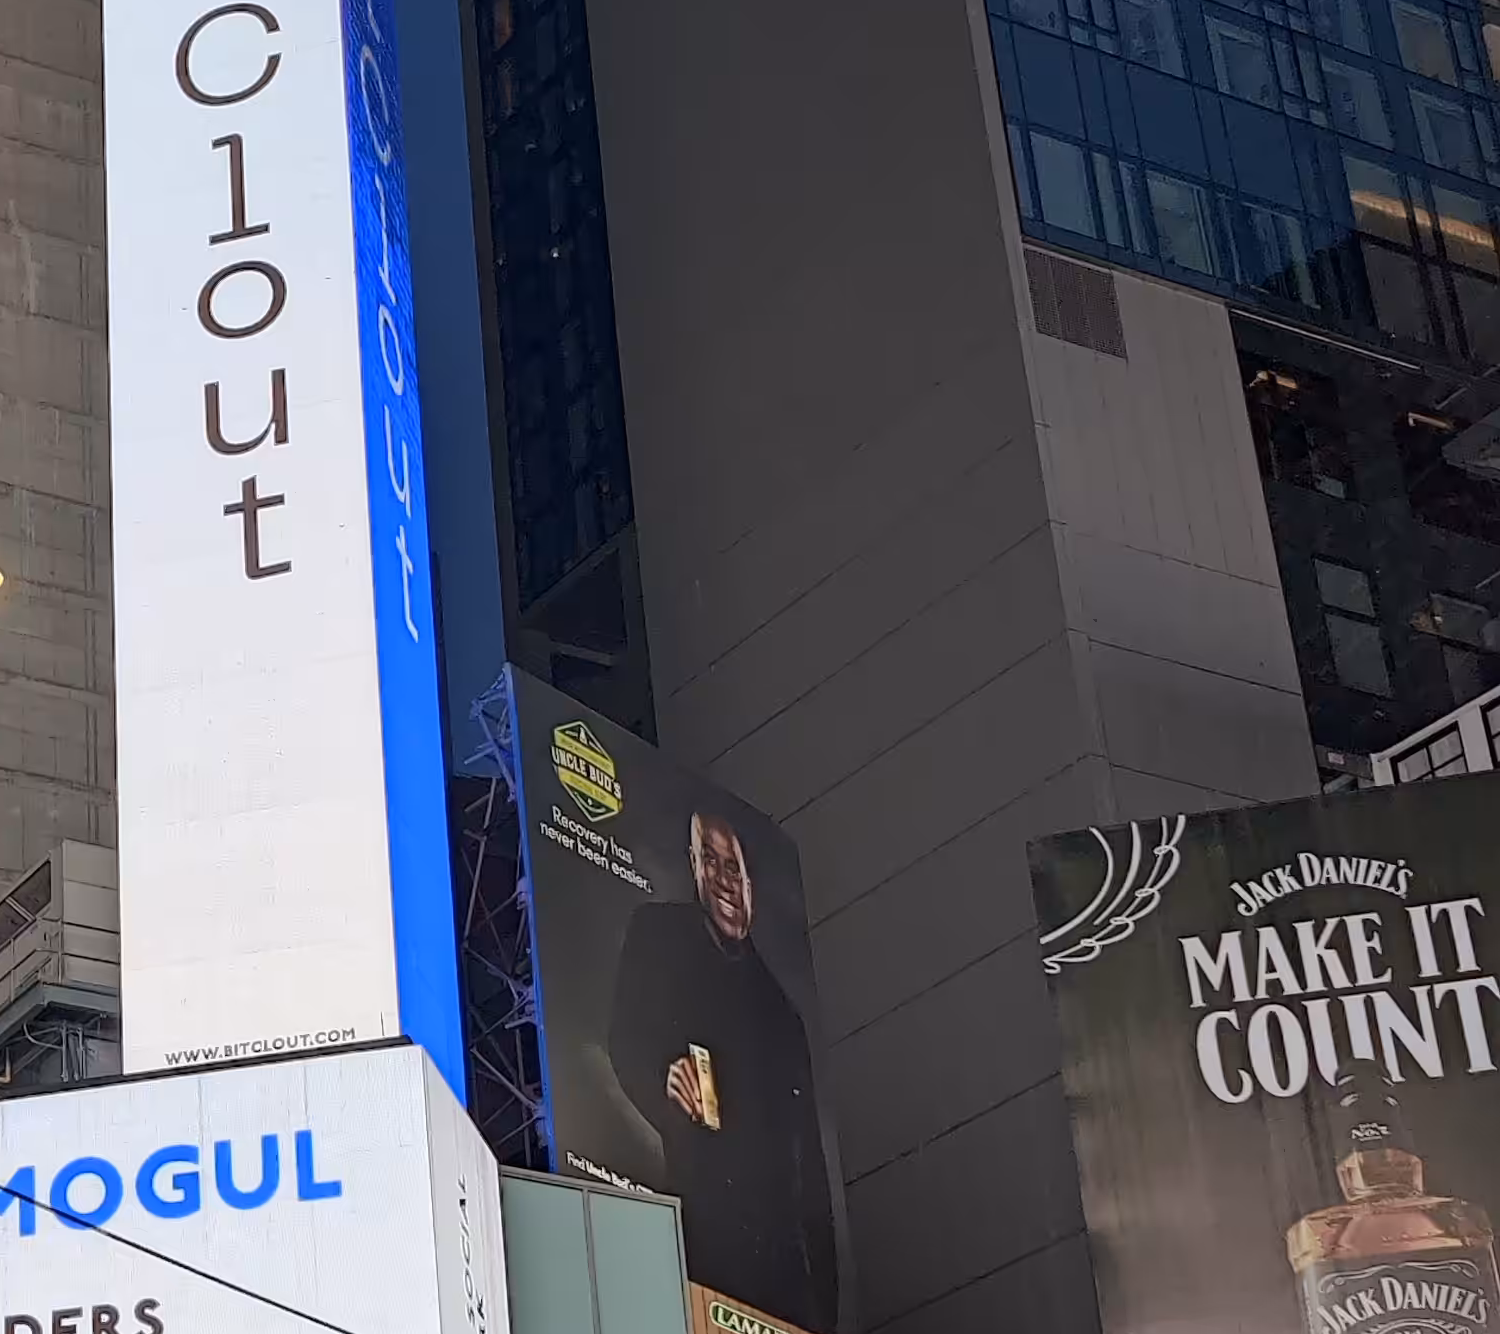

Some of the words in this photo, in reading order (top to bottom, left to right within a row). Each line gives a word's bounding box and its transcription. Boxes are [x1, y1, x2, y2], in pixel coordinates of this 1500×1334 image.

[551, 745, 587, 776] UNCLE
[588, 763, 622, 800] BUD'S
[539, 821, 576, 851] never
[577, 836, 610, 871] been
[611, 860, 654, 894] easier.
[551, 805, 609, 854] Recovery
[610, 836, 633, 865] has
[1228, 863, 1300, 918] JACK
[1298, 851, 1415, 900] DANIEL'S
[1178, 910, 1392, 1009] MAKE
[1404, 896, 1486, 980] IT
[164, 1027, 357, 1066] WWW.BITCLOUT.COM
[1195, 975, 1500, 1105] COUNT
[1379, 1276, 1491, 1328] DANIEL'S
